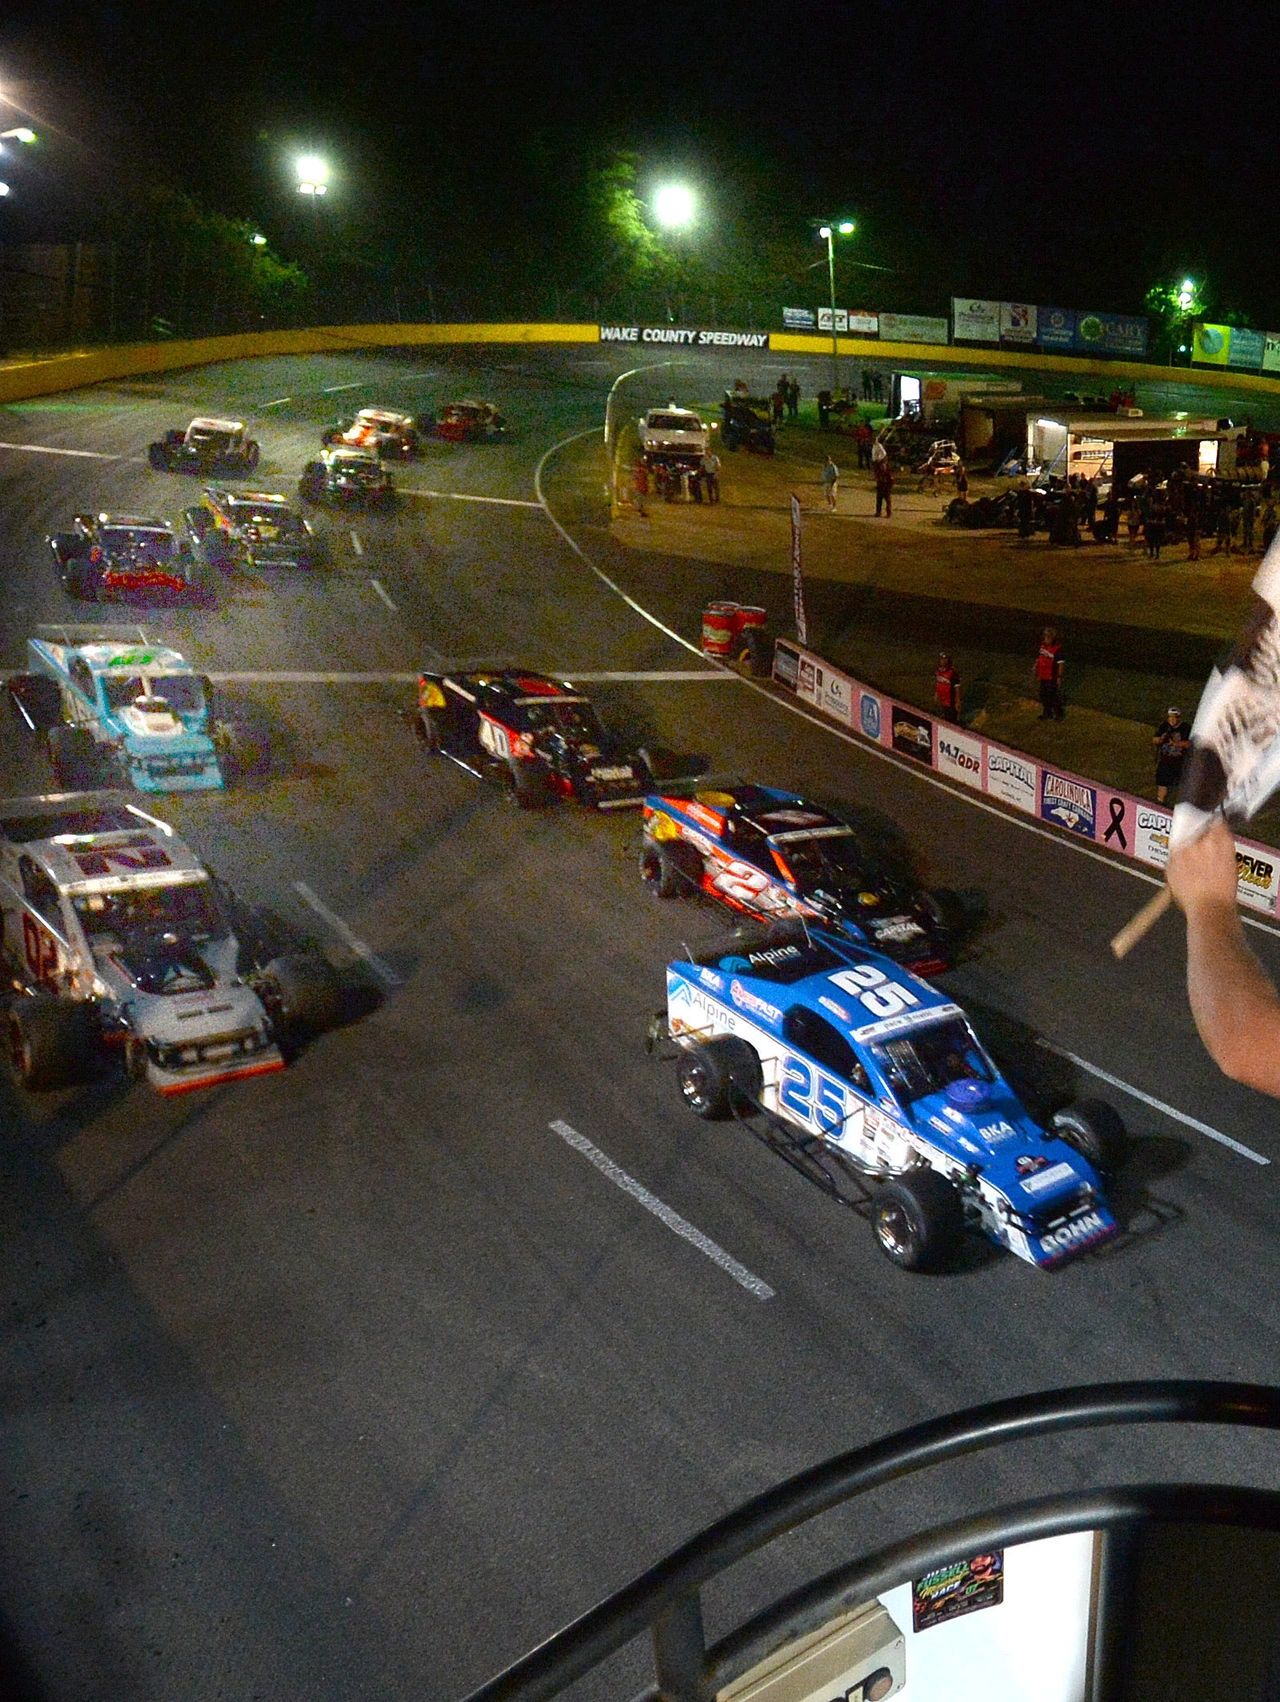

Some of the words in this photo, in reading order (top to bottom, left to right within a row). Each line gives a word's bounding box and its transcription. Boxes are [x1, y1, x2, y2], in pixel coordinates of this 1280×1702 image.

[600, 327, 639, 342] WAKE
[641, 329, 696, 345] COUNTY
[698, 331, 768, 348] SPEEDWAY
[939, 741, 959, 759] 94.7
[958, 754, 980, 774] QDR
[988, 755, 1035, 790] CAPITAL
[1138, 812, 1172, 834] CAPI
[1236, 851, 1273, 879] REVER
[748, 945, 799, 969] Alpine
[827, 964, 920, 1018] 25
[693, 992, 737, 1031] Alpine
[779, 1051, 847, 1142] 25
[978, 1120, 1016, 1142] BKA
